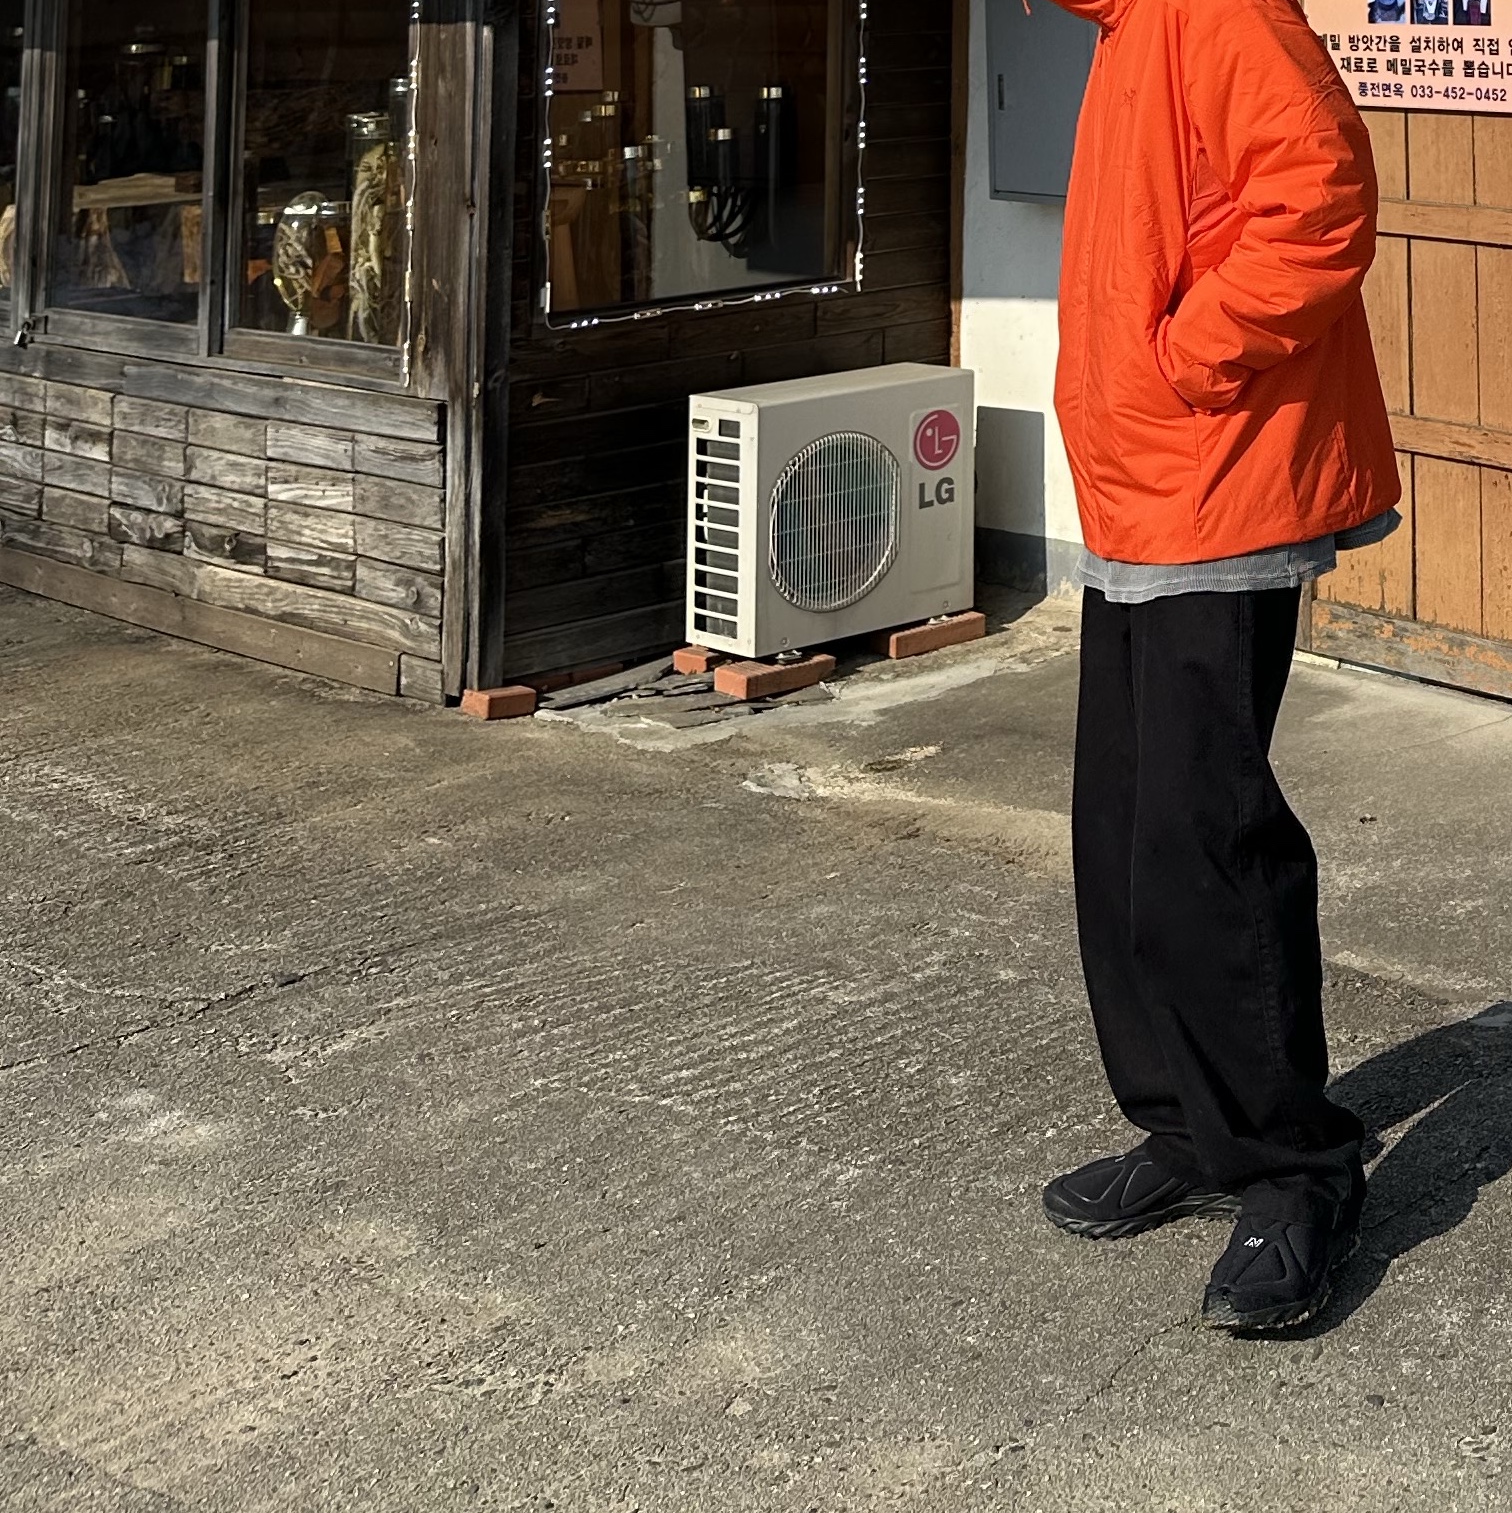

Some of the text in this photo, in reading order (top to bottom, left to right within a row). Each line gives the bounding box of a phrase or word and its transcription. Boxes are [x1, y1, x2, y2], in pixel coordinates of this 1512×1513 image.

[1348, 34, 1401, 53] 방앗간을
[1409, 36, 1464, 55] 설치하여
[1472, 38, 1500, 56] 직접
[1340, 57, 1379, 74] 재료로
[1386, 58, 1455, 77] 메밀국수를
[1358, 82, 1507, 102] 풍전면옥 033-452-0452
[918, 476, 956, 510] LG
